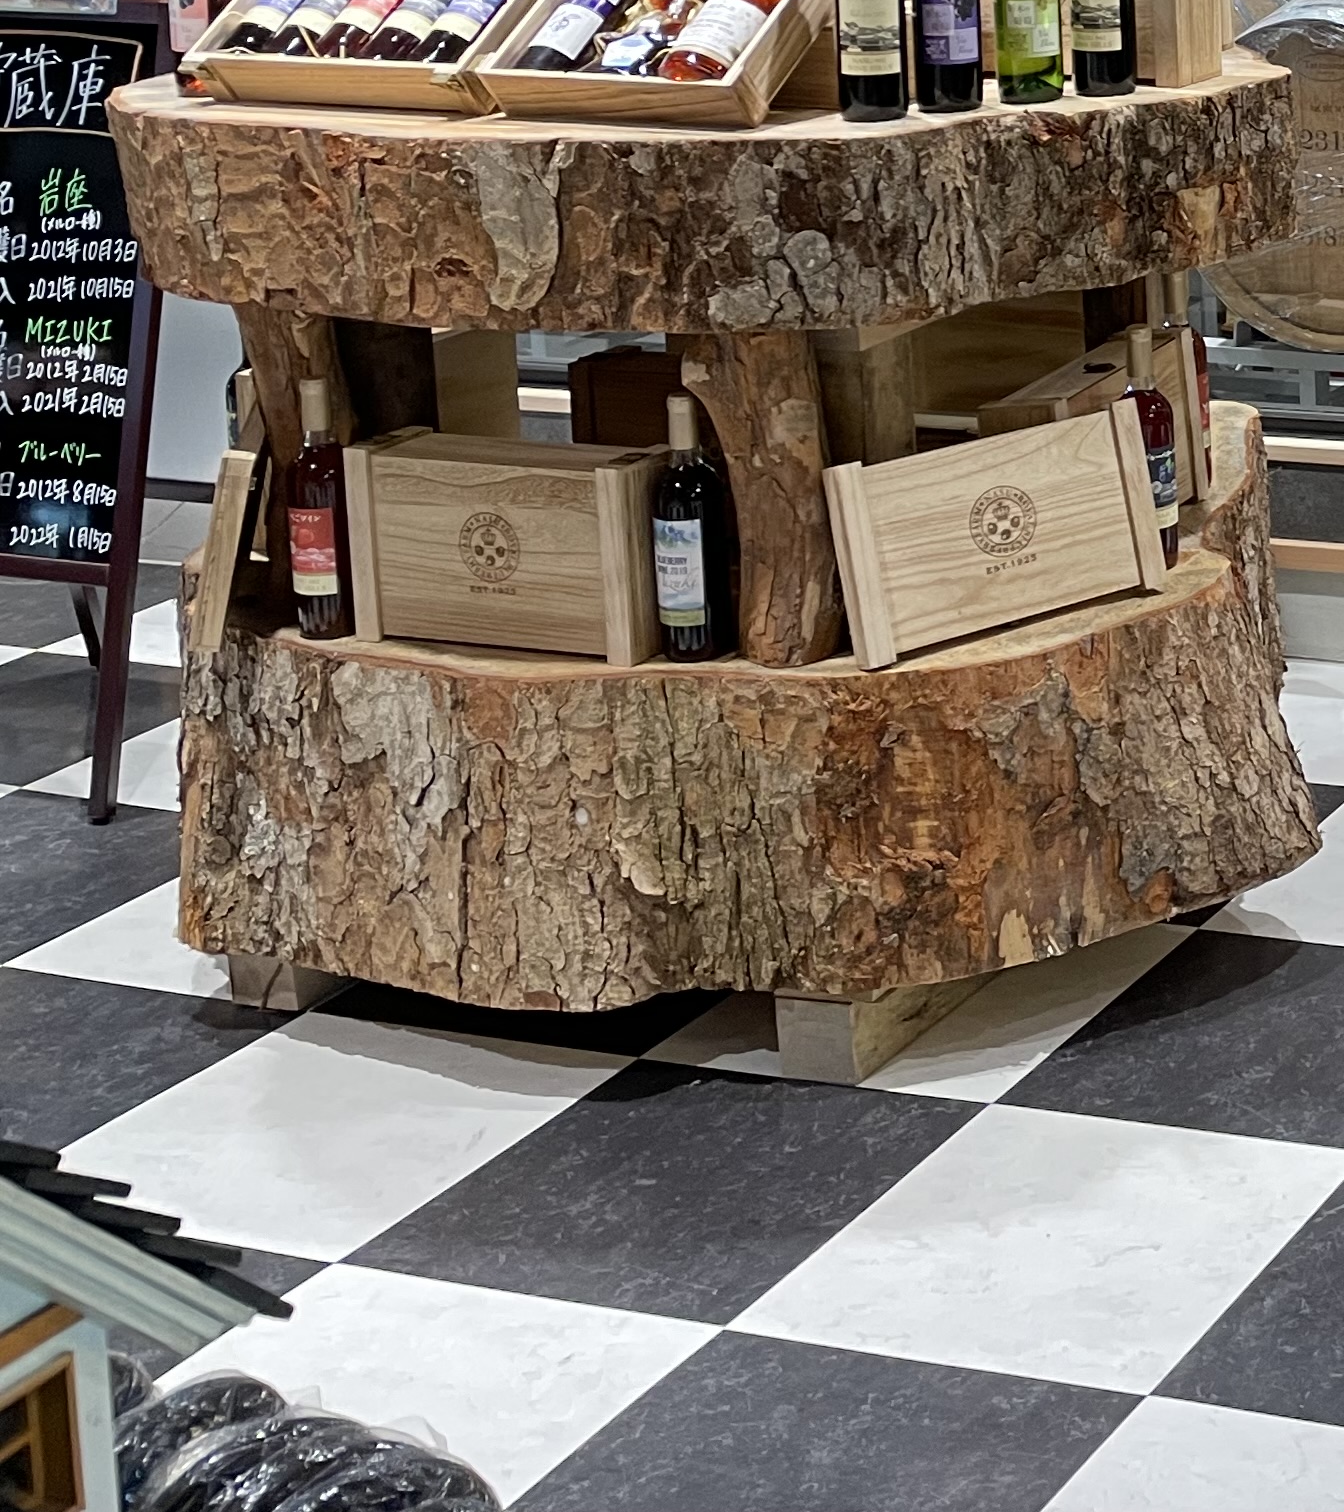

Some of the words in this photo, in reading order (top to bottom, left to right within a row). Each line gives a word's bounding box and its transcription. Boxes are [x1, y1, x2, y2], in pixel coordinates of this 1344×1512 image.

[39, 168, 93, 216] 岩座
[25, 316, 113, 344] MIZUKI
[18, 440, 102, 466] ブルーベリー
